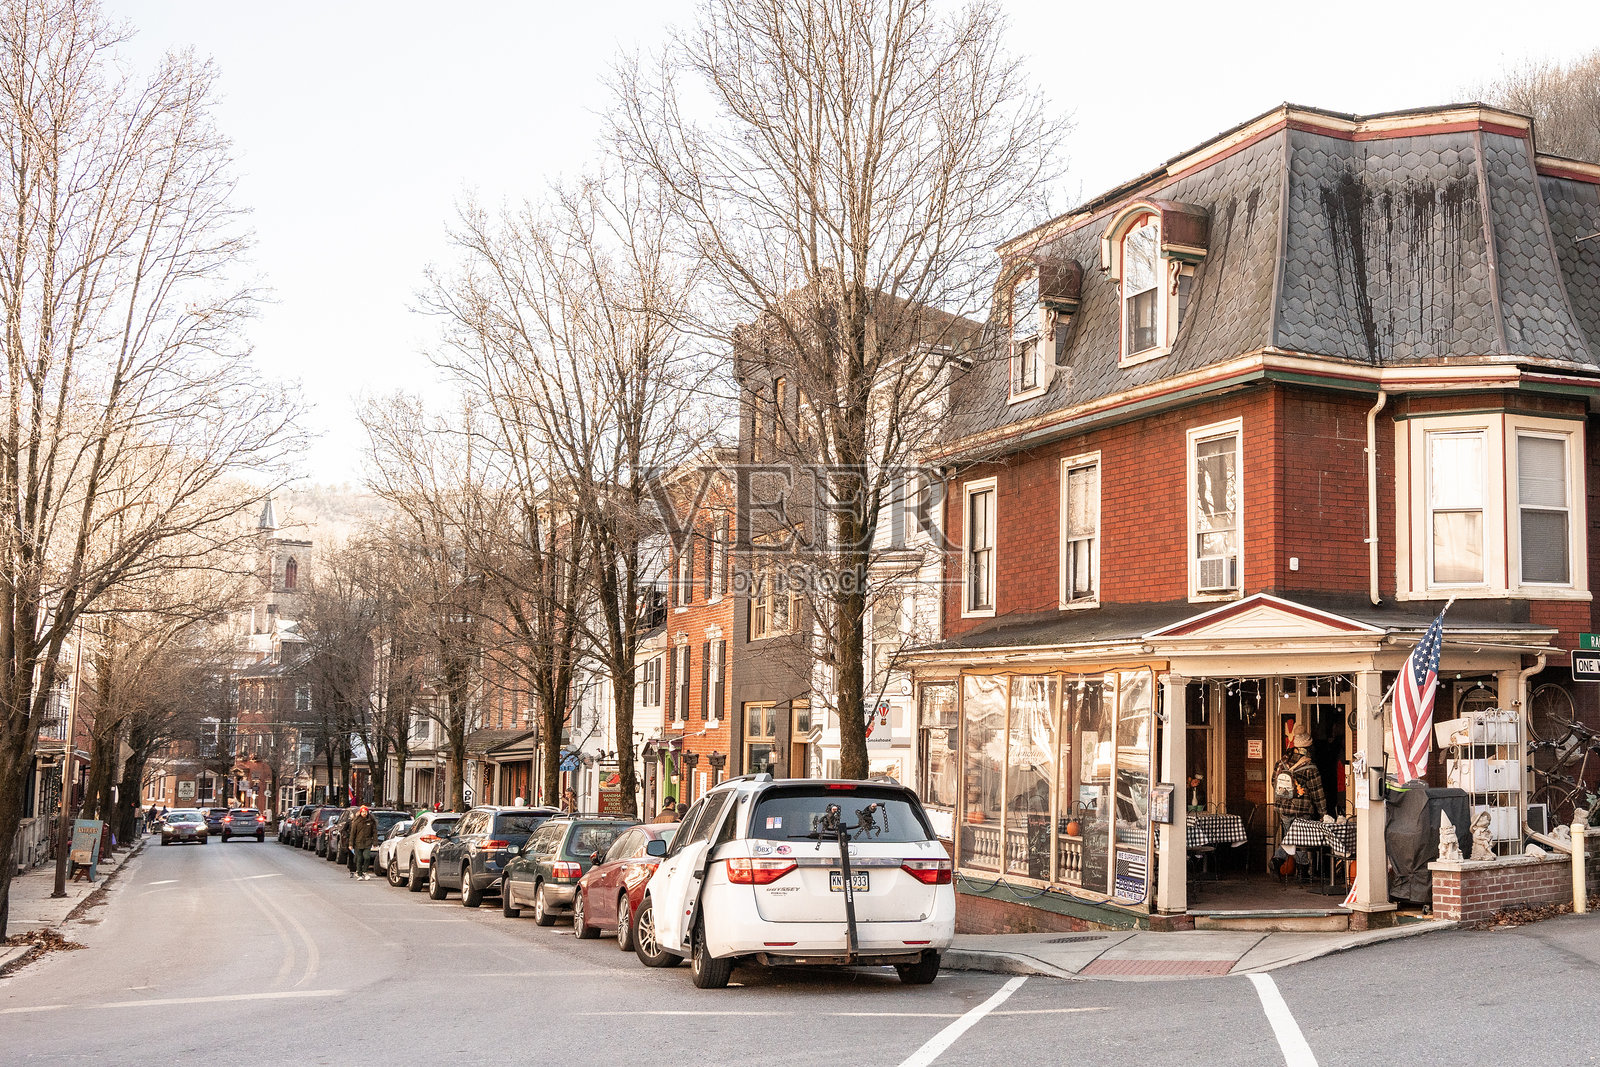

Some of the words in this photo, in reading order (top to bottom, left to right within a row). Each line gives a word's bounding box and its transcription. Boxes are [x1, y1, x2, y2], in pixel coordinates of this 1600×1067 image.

[1591, 635, 1600, 648] RA
[1578, 660, 1594, 671] ONE
[1124, 853, 1140, 862] SUPPORT
[832, 876, 843, 886] KN
[853, 876, 867, 886] 933
[1118, 879, 1143, 893] POLICE
